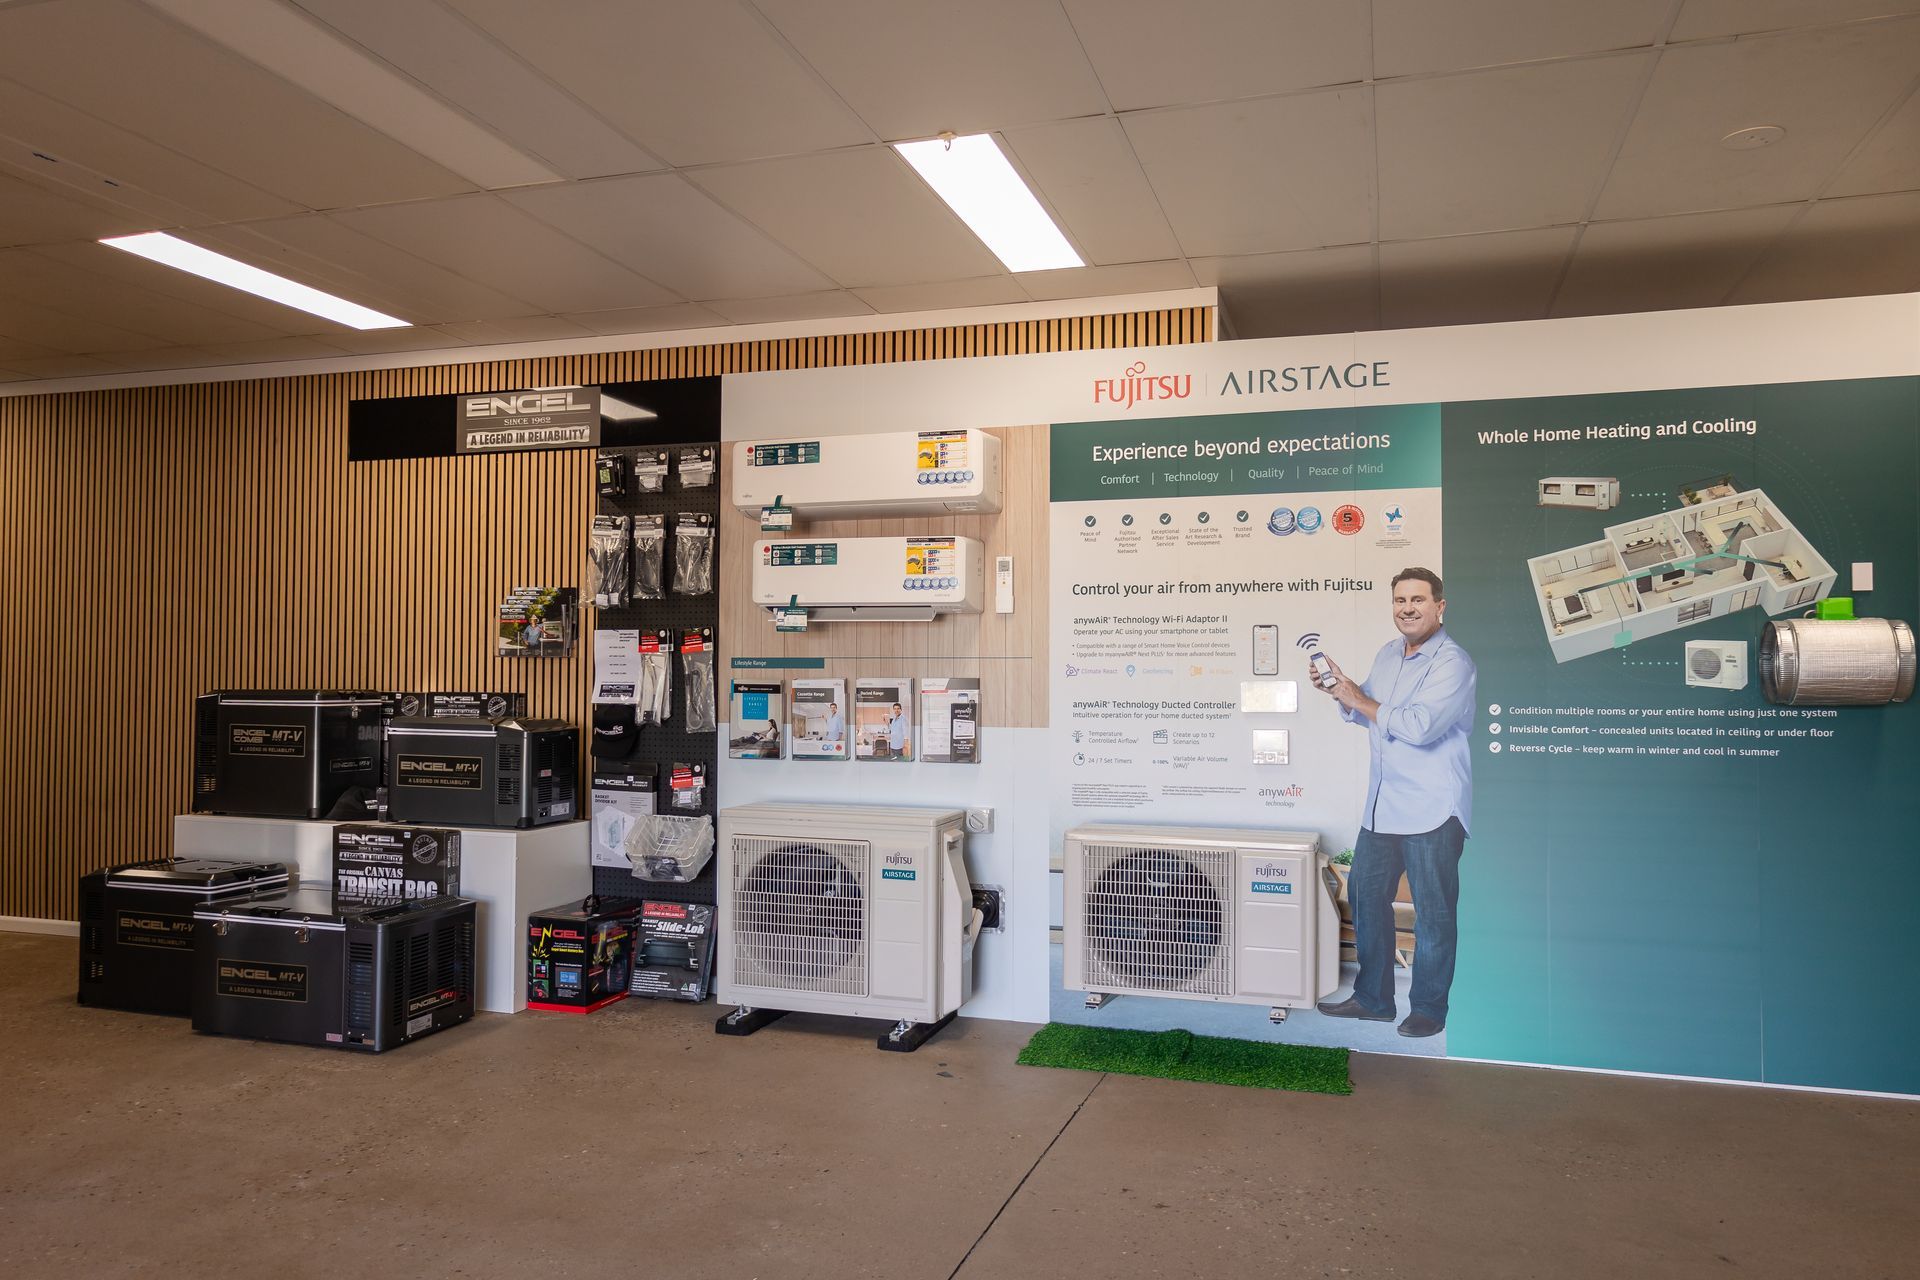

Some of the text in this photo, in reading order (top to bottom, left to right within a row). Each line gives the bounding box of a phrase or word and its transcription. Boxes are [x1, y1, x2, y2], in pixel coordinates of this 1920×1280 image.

[1094, 361, 1191, 409] FUJITSU
[1220, 361, 1390, 396] AIRSTAGE
[467, 392, 591, 417] ENGEL
[471, 429, 585, 446] A LEGEND IN RELIABILITY
[1478, 418, 1757, 445] Whole Home Heating and Cooling
[1092, 432, 1390, 464] Experience beyond expectations
[1100, 463, 1384, 485] Comfort Technology Quality Peace of Mind
[1343, 512, 1352, 522] 5
[1072, 579, 1372, 597] Control your air from anywhere with Fujitsu
[1113, 616, 1159, 625] Technology
[1186, 616, 1219, 624] Adaptor
[1113, 701, 1236, 711] Technology Ducted Controller
[1509, 705, 1552, 716] Condition
[1555, 706, 1594, 719] multiple
[1642, 709, 1663, 719] your
[1666, 707, 1695, 717] entire
[1698, 707, 1725, 717] home
[1728, 708, 1755, 719] using
[1757, 708, 1777, 720] just
[1801, 709, 1837, 720] system
[1101, 712, 1132, 721] operation
[272, 730, 302, 741] MT-V
[1509, 725, 1548, 734] Invisible
[1551, 725, 1589, 735] Comfort
[1599, 726, 1647, 736] concealed
[1649, 726, 1674, 736] units
[1677, 727, 1713, 737] located
[1715, 727, 1725, 737] in
[1728, 727, 1762, 738] ceiling
[1777, 728, 1807, 737] under
[1810, 728, 1834, 738] floor
[1510, 744, 1546, 753] Reverse
[1548, 743, 1573, 755] Cycle
[1582, 745, 1605, 756] keep
[1637, 745, 1646, 754] in
[1648, 746, 1680, 755] winter
[1682, 746, 1700, 755] and
[1703, 746, 1724, 756] cool
[1727, 747, 1737, 756] in
[1739, 748, 1780, 757] summer
[400, 762, 479, 772] ENGEL MT-V
[1266, 800, 1294, 808] technology
[339, 833, 403, 847] ENGEL
[886, 852, 912, 865] FUJITSU
[365, 866, 403, 878] CANVAS
[1256, 863, 1286, 877] FUJITSU
[405, 880, 437, 898] BAG
[120, 918, 194, 932] ENGEL MT-V
[656, 922, 705, 934] Slide-Lok
[530, 924, 584, 942] ENGEL
[220, 967, 304, 982] ENGEL MT-V
[263, 988, 295, 997] RELIABILITY
[409, 998, 440, 1011] ENGEL
